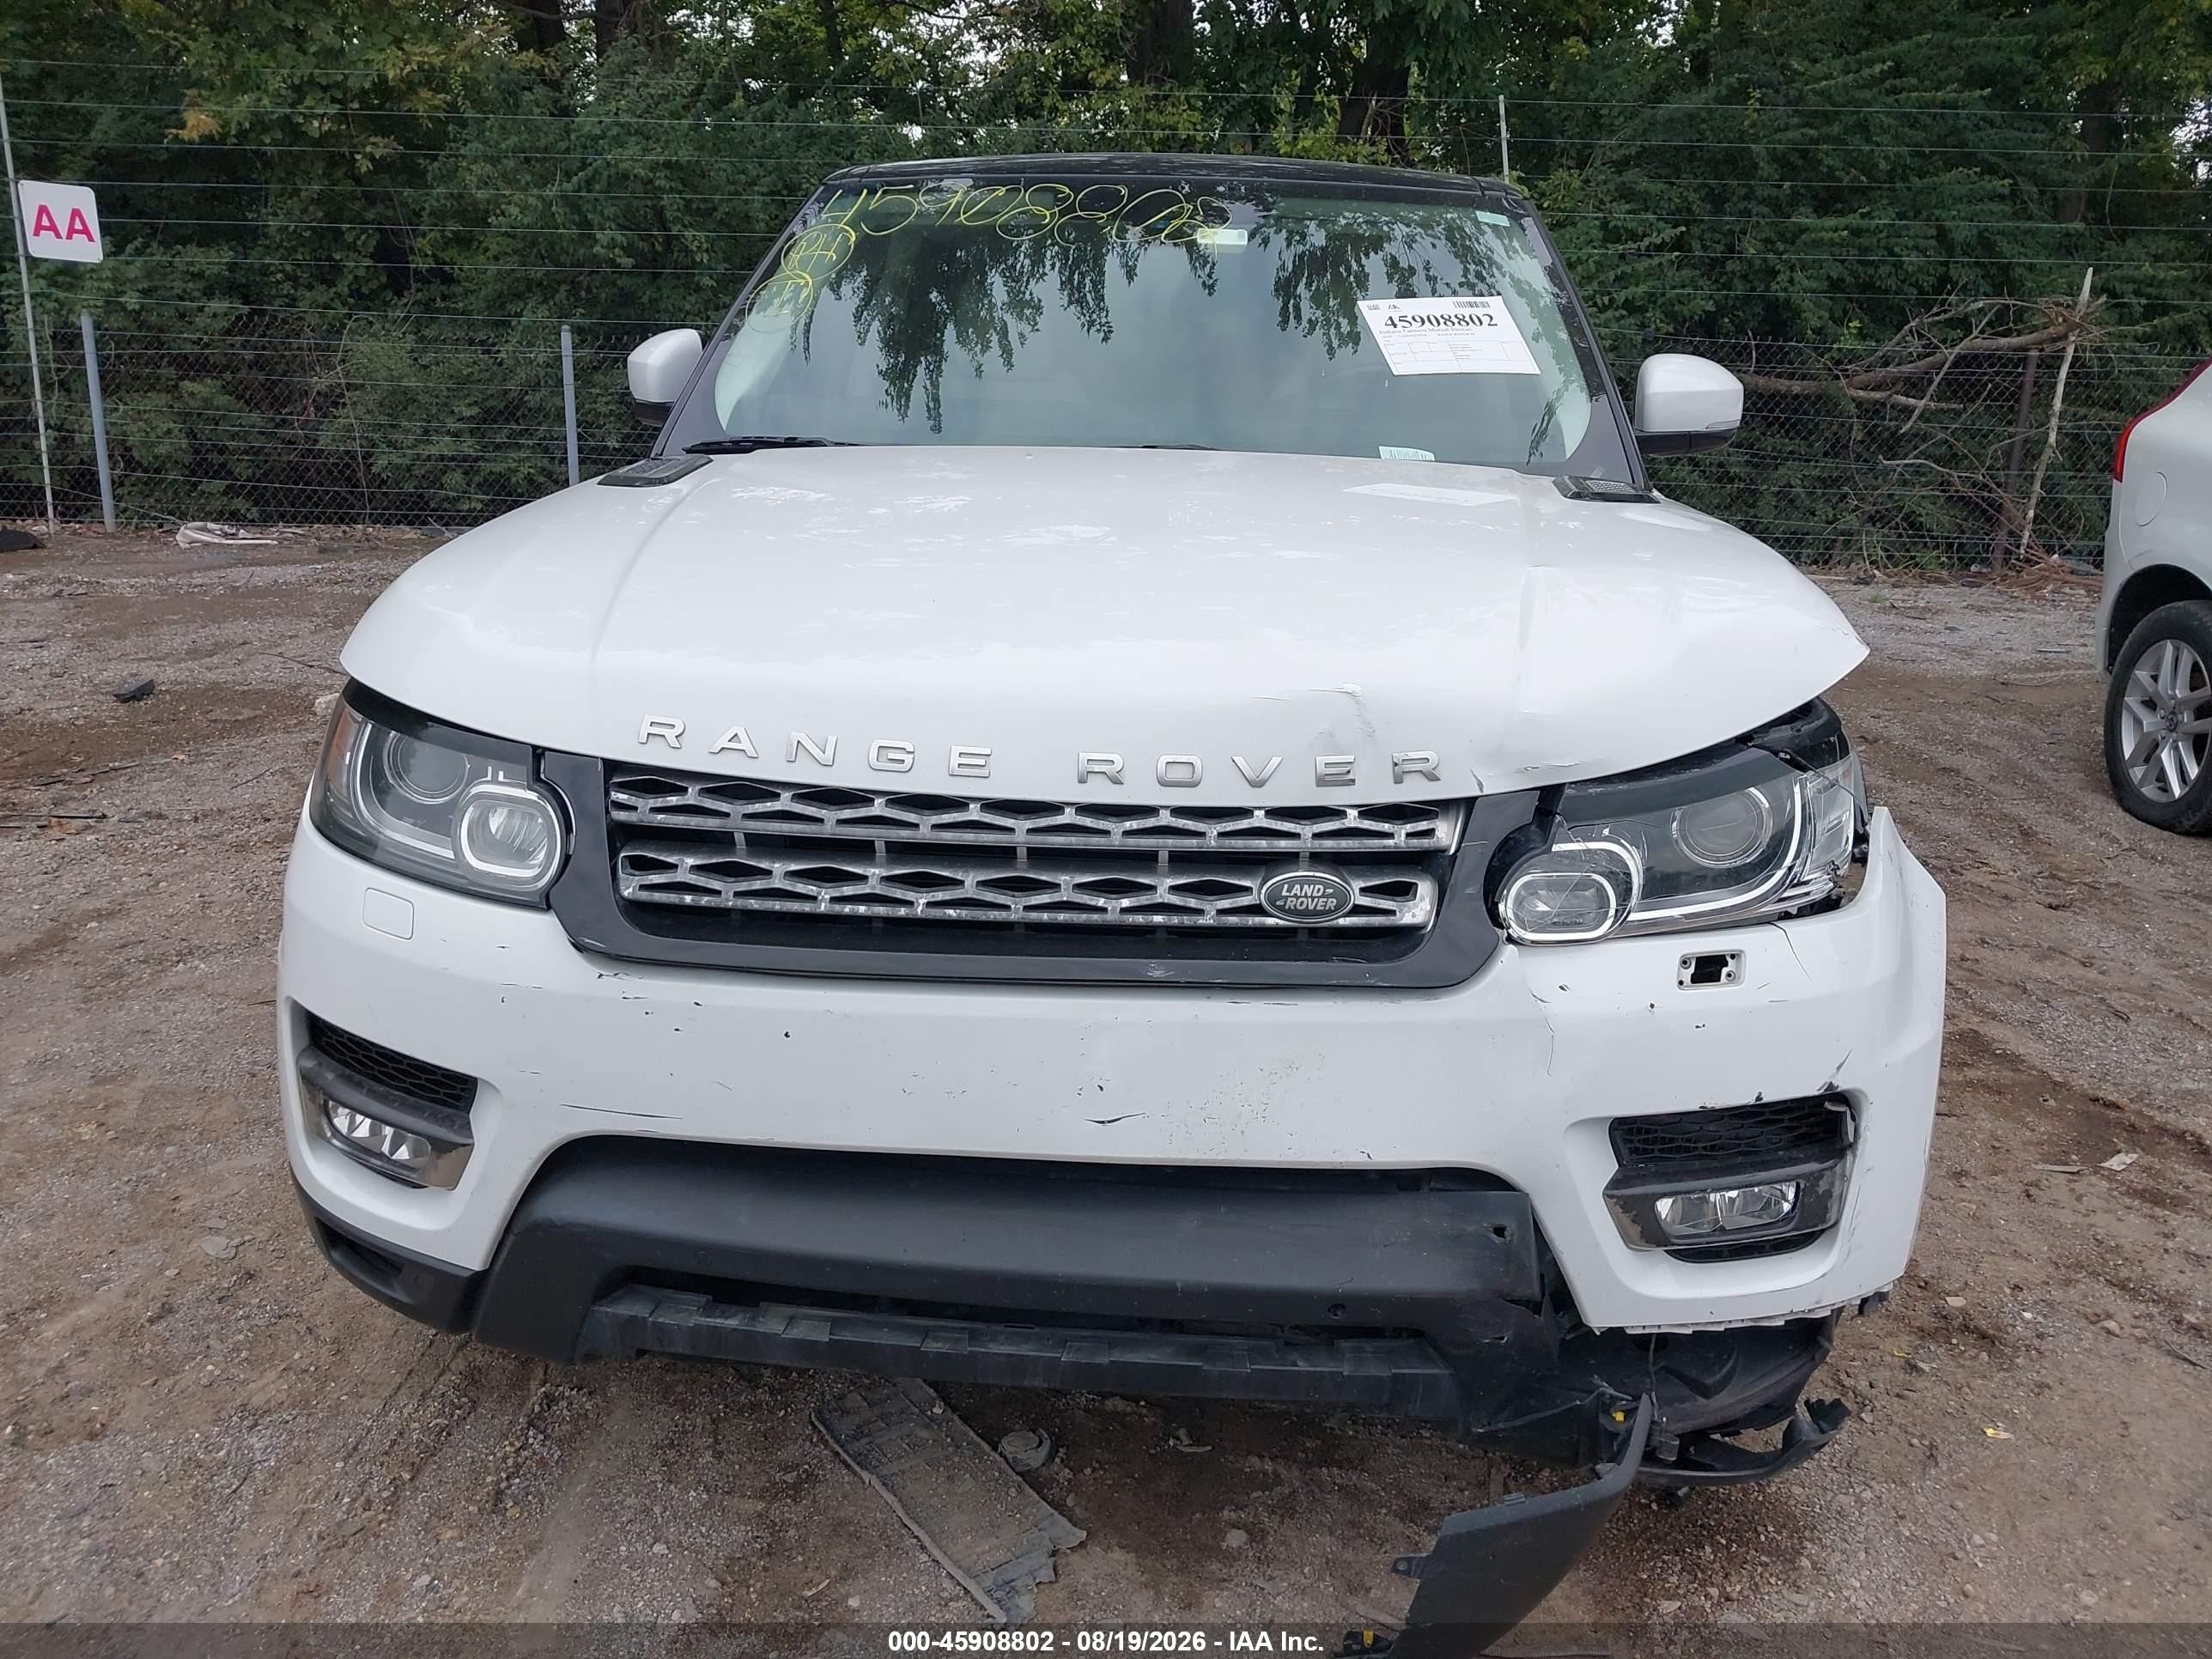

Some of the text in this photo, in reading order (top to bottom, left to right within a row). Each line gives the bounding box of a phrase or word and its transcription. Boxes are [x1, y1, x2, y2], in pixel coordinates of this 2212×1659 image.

[33, 204, 95, 242] AA
[822, 181, 1232, 260] 45908802
[1384, 313, 1498, 329] 45908802
[638, 714, 1442, 788] RANGE ROVER
[1280, 884, 1324, 896] LAND
[1285, 897, 1337, 910] ROVER
